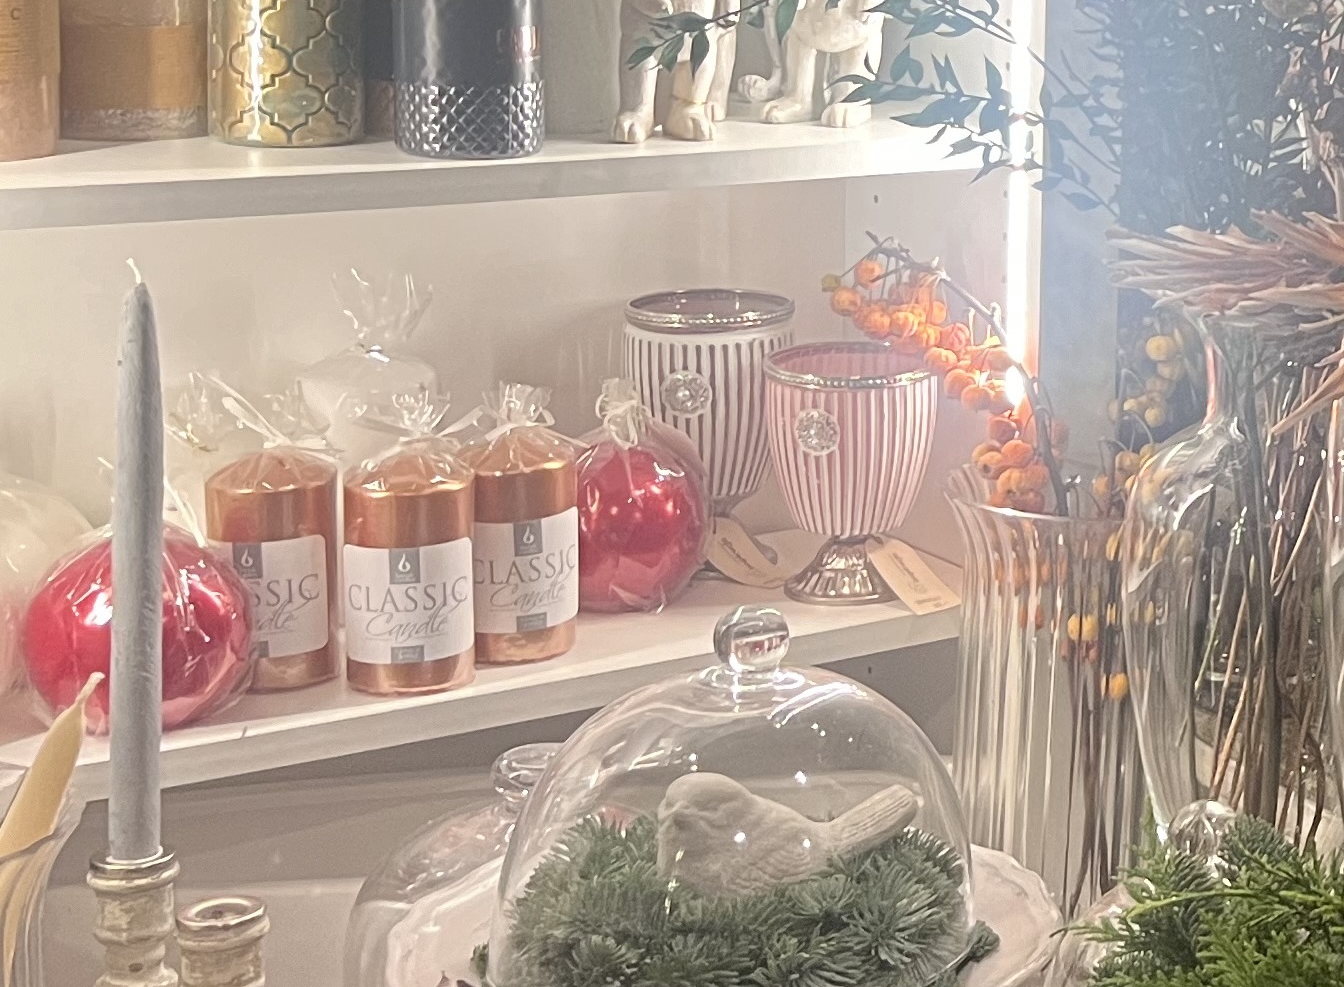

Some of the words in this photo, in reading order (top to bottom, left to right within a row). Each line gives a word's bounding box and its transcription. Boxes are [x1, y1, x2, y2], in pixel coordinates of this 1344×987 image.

[473, 543, 576, 585] CLASSIC
[253, 573, 321, 608] SSIC
[348, 576, 468, 613] CLASSIC
[489, 572, 566, 613] Candle
[256, 598, 299, 631] dle
[366, 598, 449, 642] Candle
